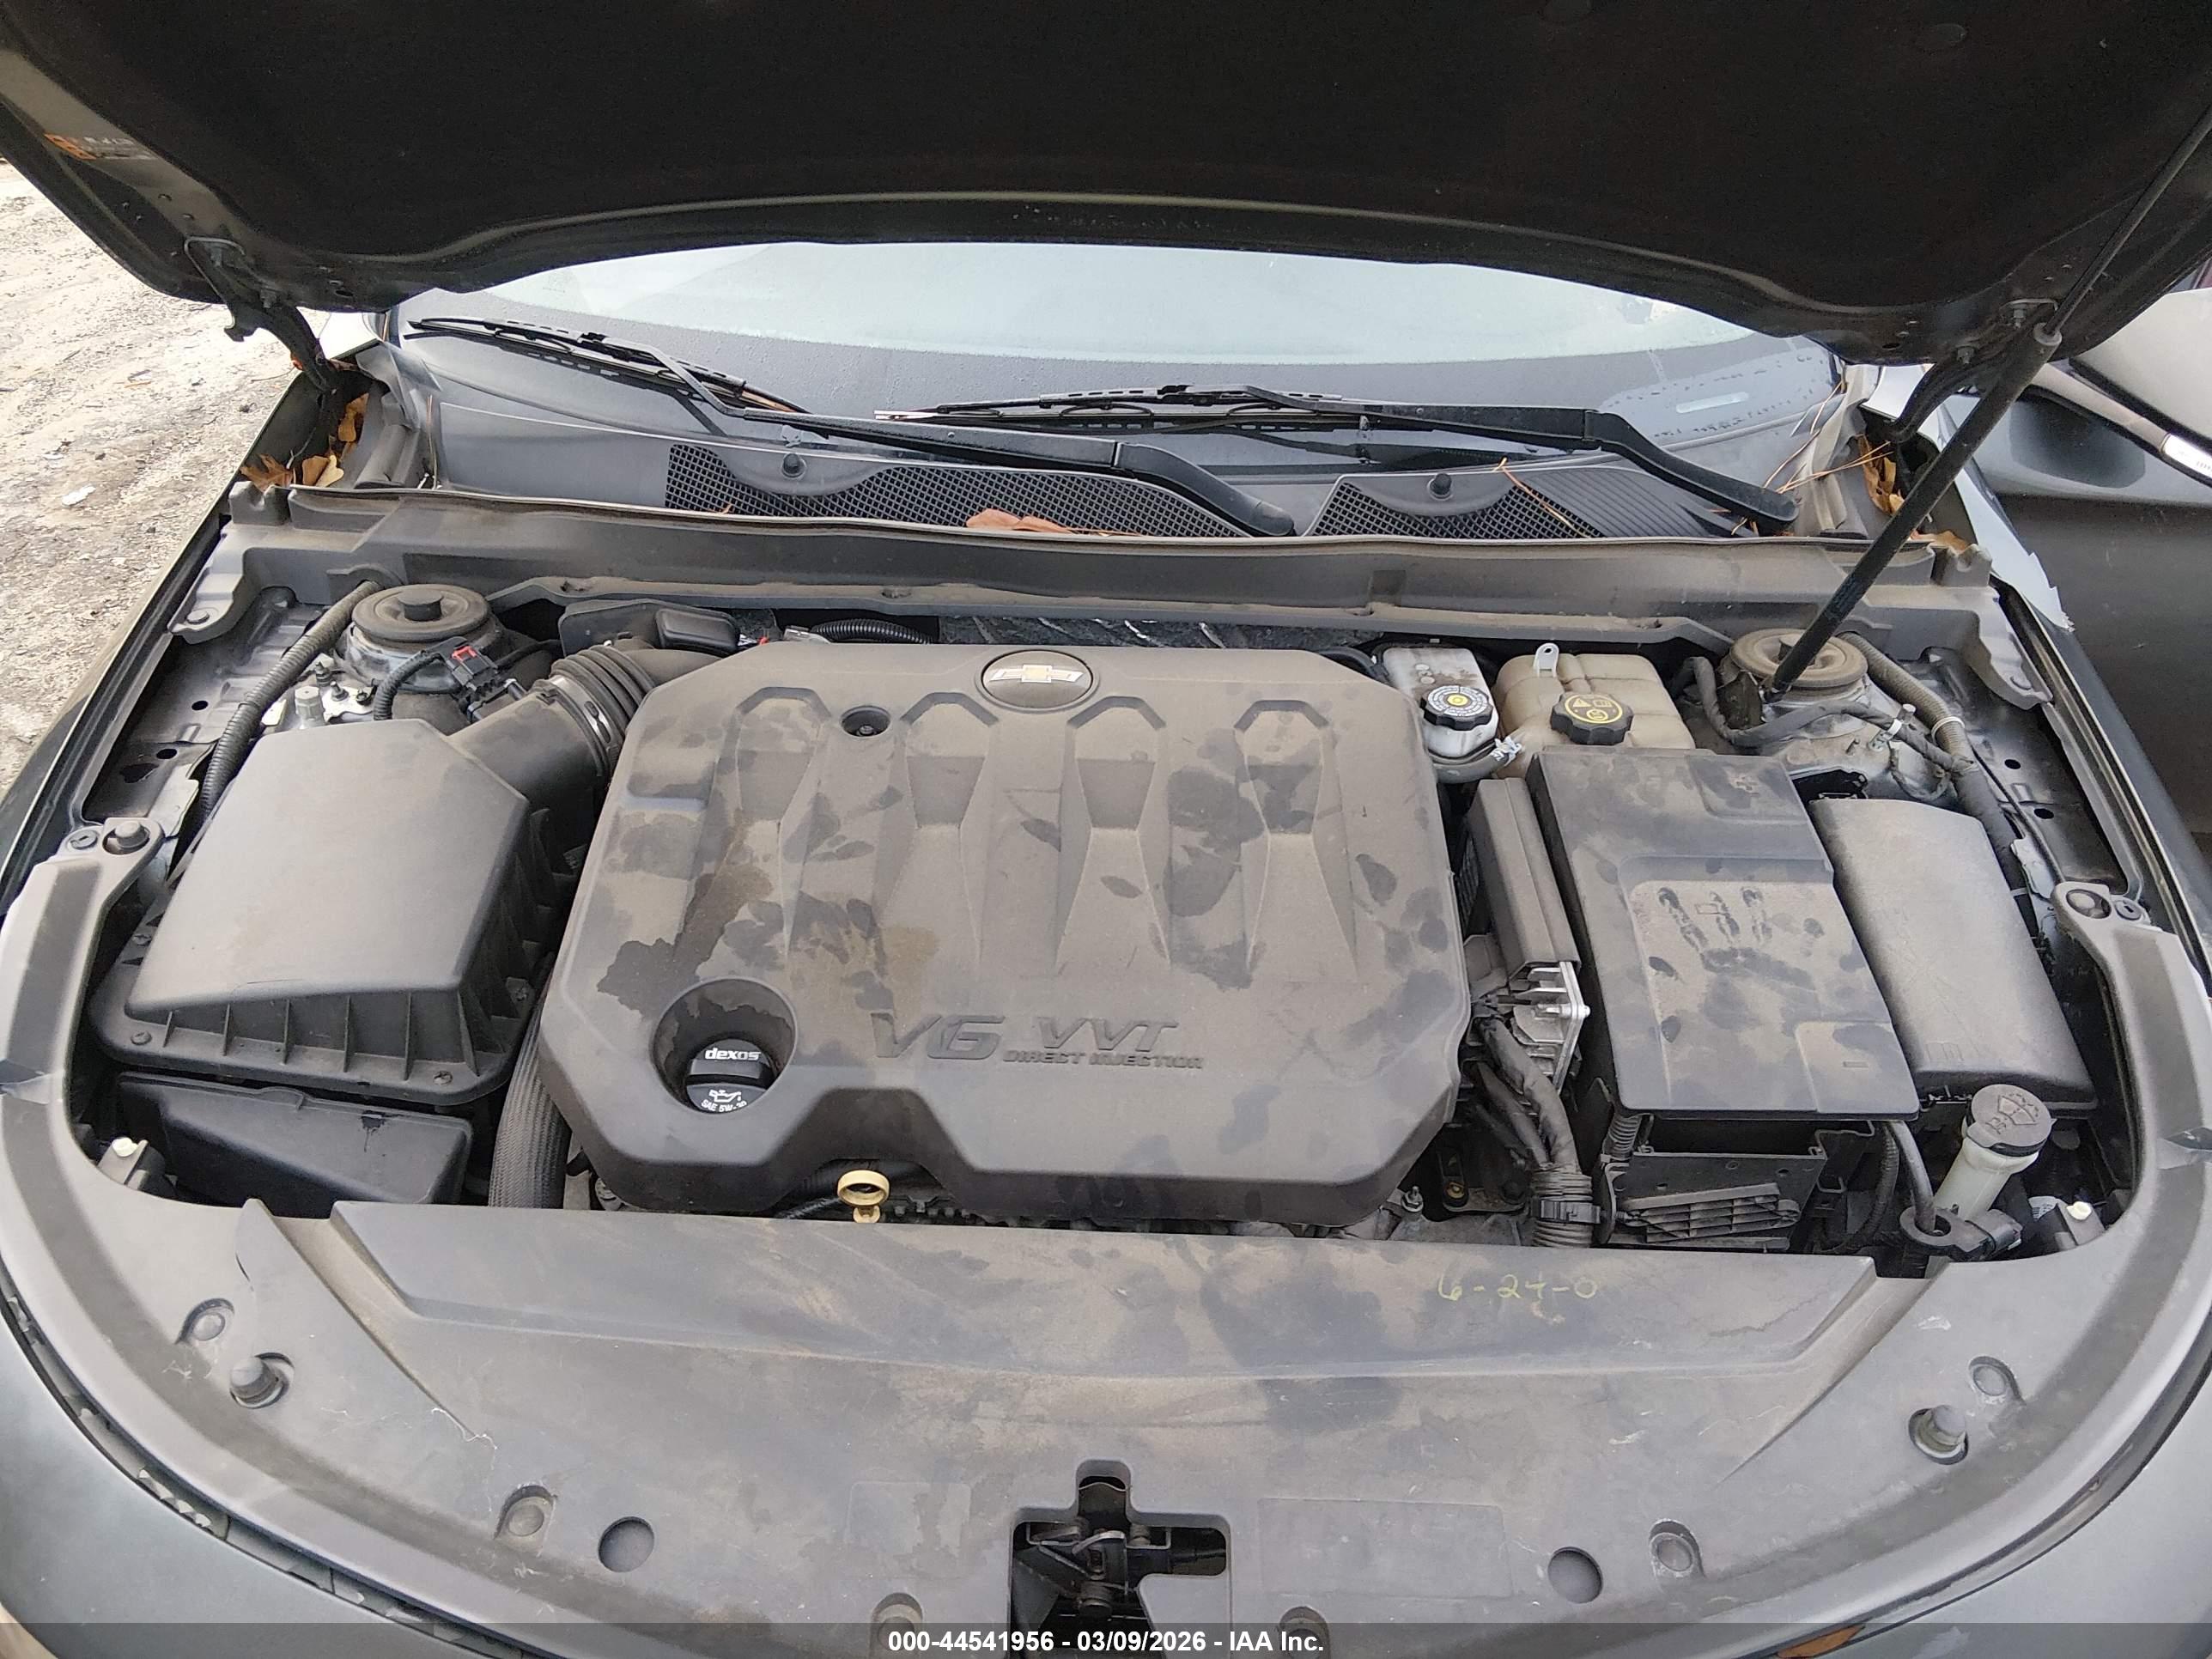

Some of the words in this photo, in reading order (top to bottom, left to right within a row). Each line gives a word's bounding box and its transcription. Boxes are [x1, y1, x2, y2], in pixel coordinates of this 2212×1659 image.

[870, 1012, 1006, 1060] V6
[1037, 1016, 1179, 1052] VVT
[704, 1047, 762, 1061] dexos
[1003, 1049, 1086, 1065] DIRECT
[1089, 1053, 1203, 1069] INJECTION
[701, 1099, 718, 1112] SAE
